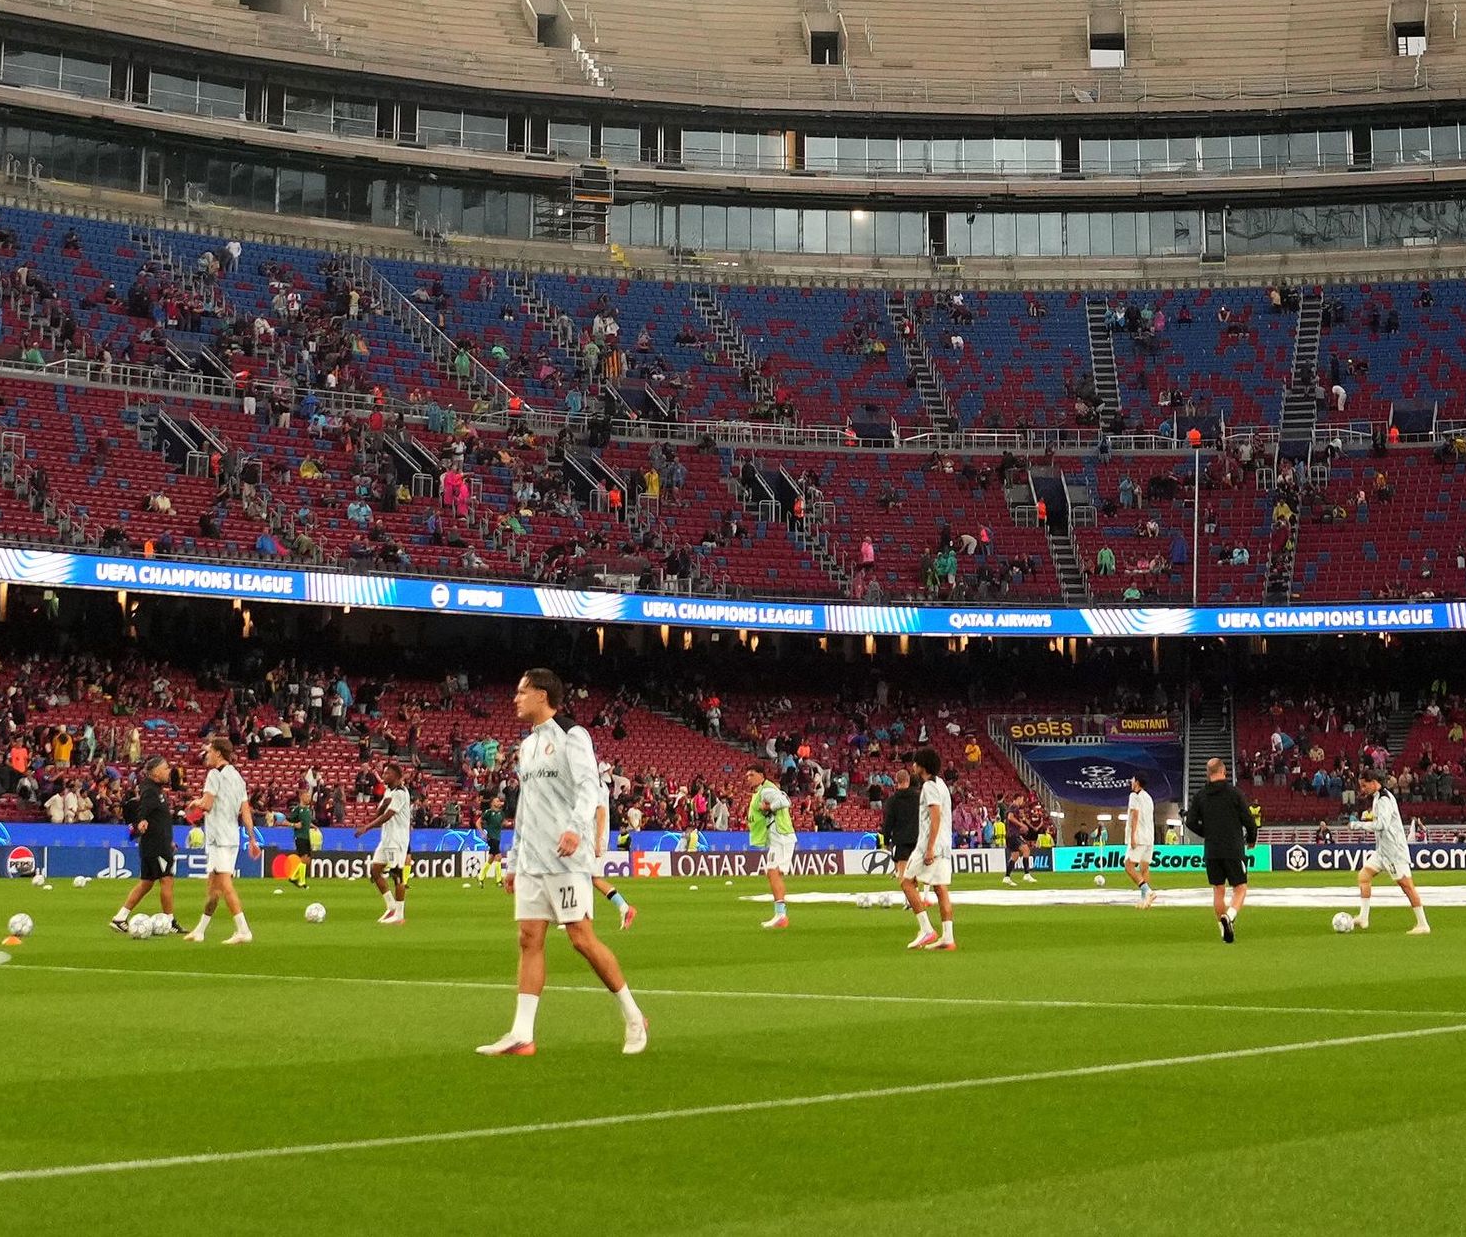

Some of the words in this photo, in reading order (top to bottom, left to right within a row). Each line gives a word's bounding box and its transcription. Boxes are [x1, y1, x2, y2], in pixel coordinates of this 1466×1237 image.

[96, 563, 137, 582] UEFA
[139, 566, 232, 589] CHAMPIONS
[233, 574, 293, 594] LEAGUE
[642, 601, 676, 619] UEFA
[678, 603, 757, 623] CHAMPIONS
[759, 608, 813, 625] LEAGUE
[949, 613, 994, 629] QATAR
[996, 614, 1052, 627] AIRWAYS
[1217, 613, 1261, 628] UEFA
[1264, 610, 1365, 627] CHAMPIONS
[1368, 609, 1433, 625] LEAGUE
[1010, 722, 1073, 738] SOSES
[604, 850, 662, 877] edEx
[559, 886, 578, 909] 22
